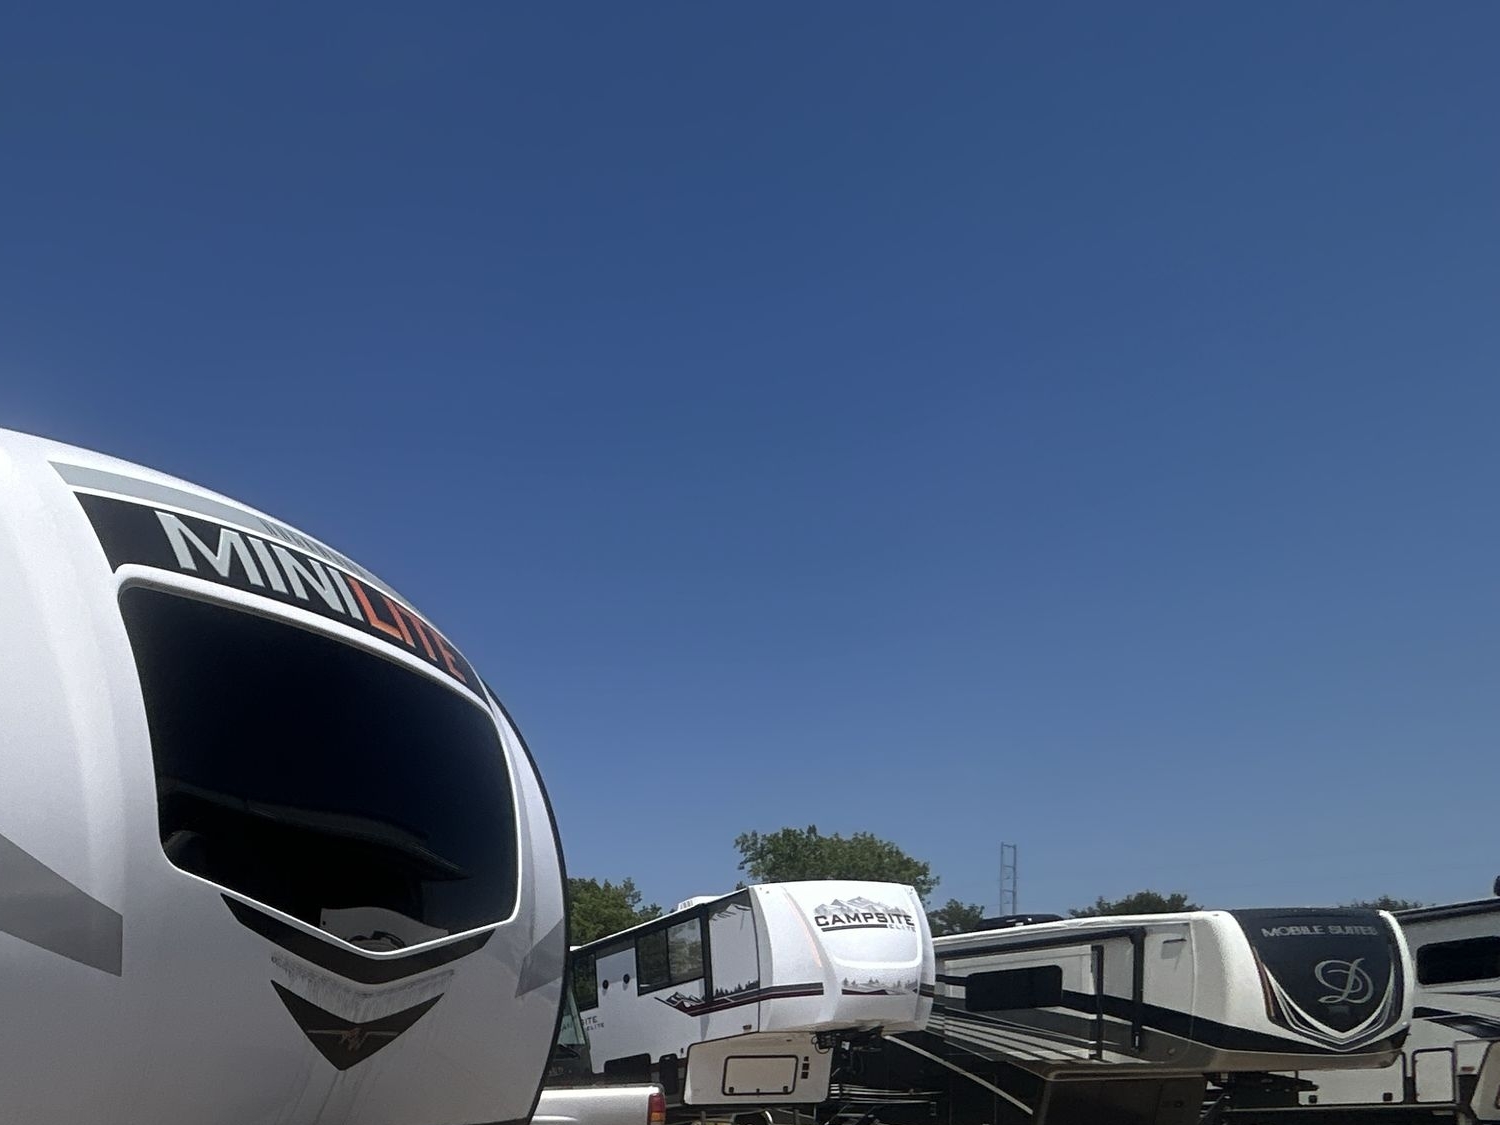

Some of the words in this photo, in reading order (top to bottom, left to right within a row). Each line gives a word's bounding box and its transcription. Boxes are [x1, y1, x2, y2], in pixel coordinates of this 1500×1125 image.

[154, 510, 467, 683] MINILITE
[814, 912, 915, 928] CAMPSITE
[1261, 926, 1326, 937] MOBILE
